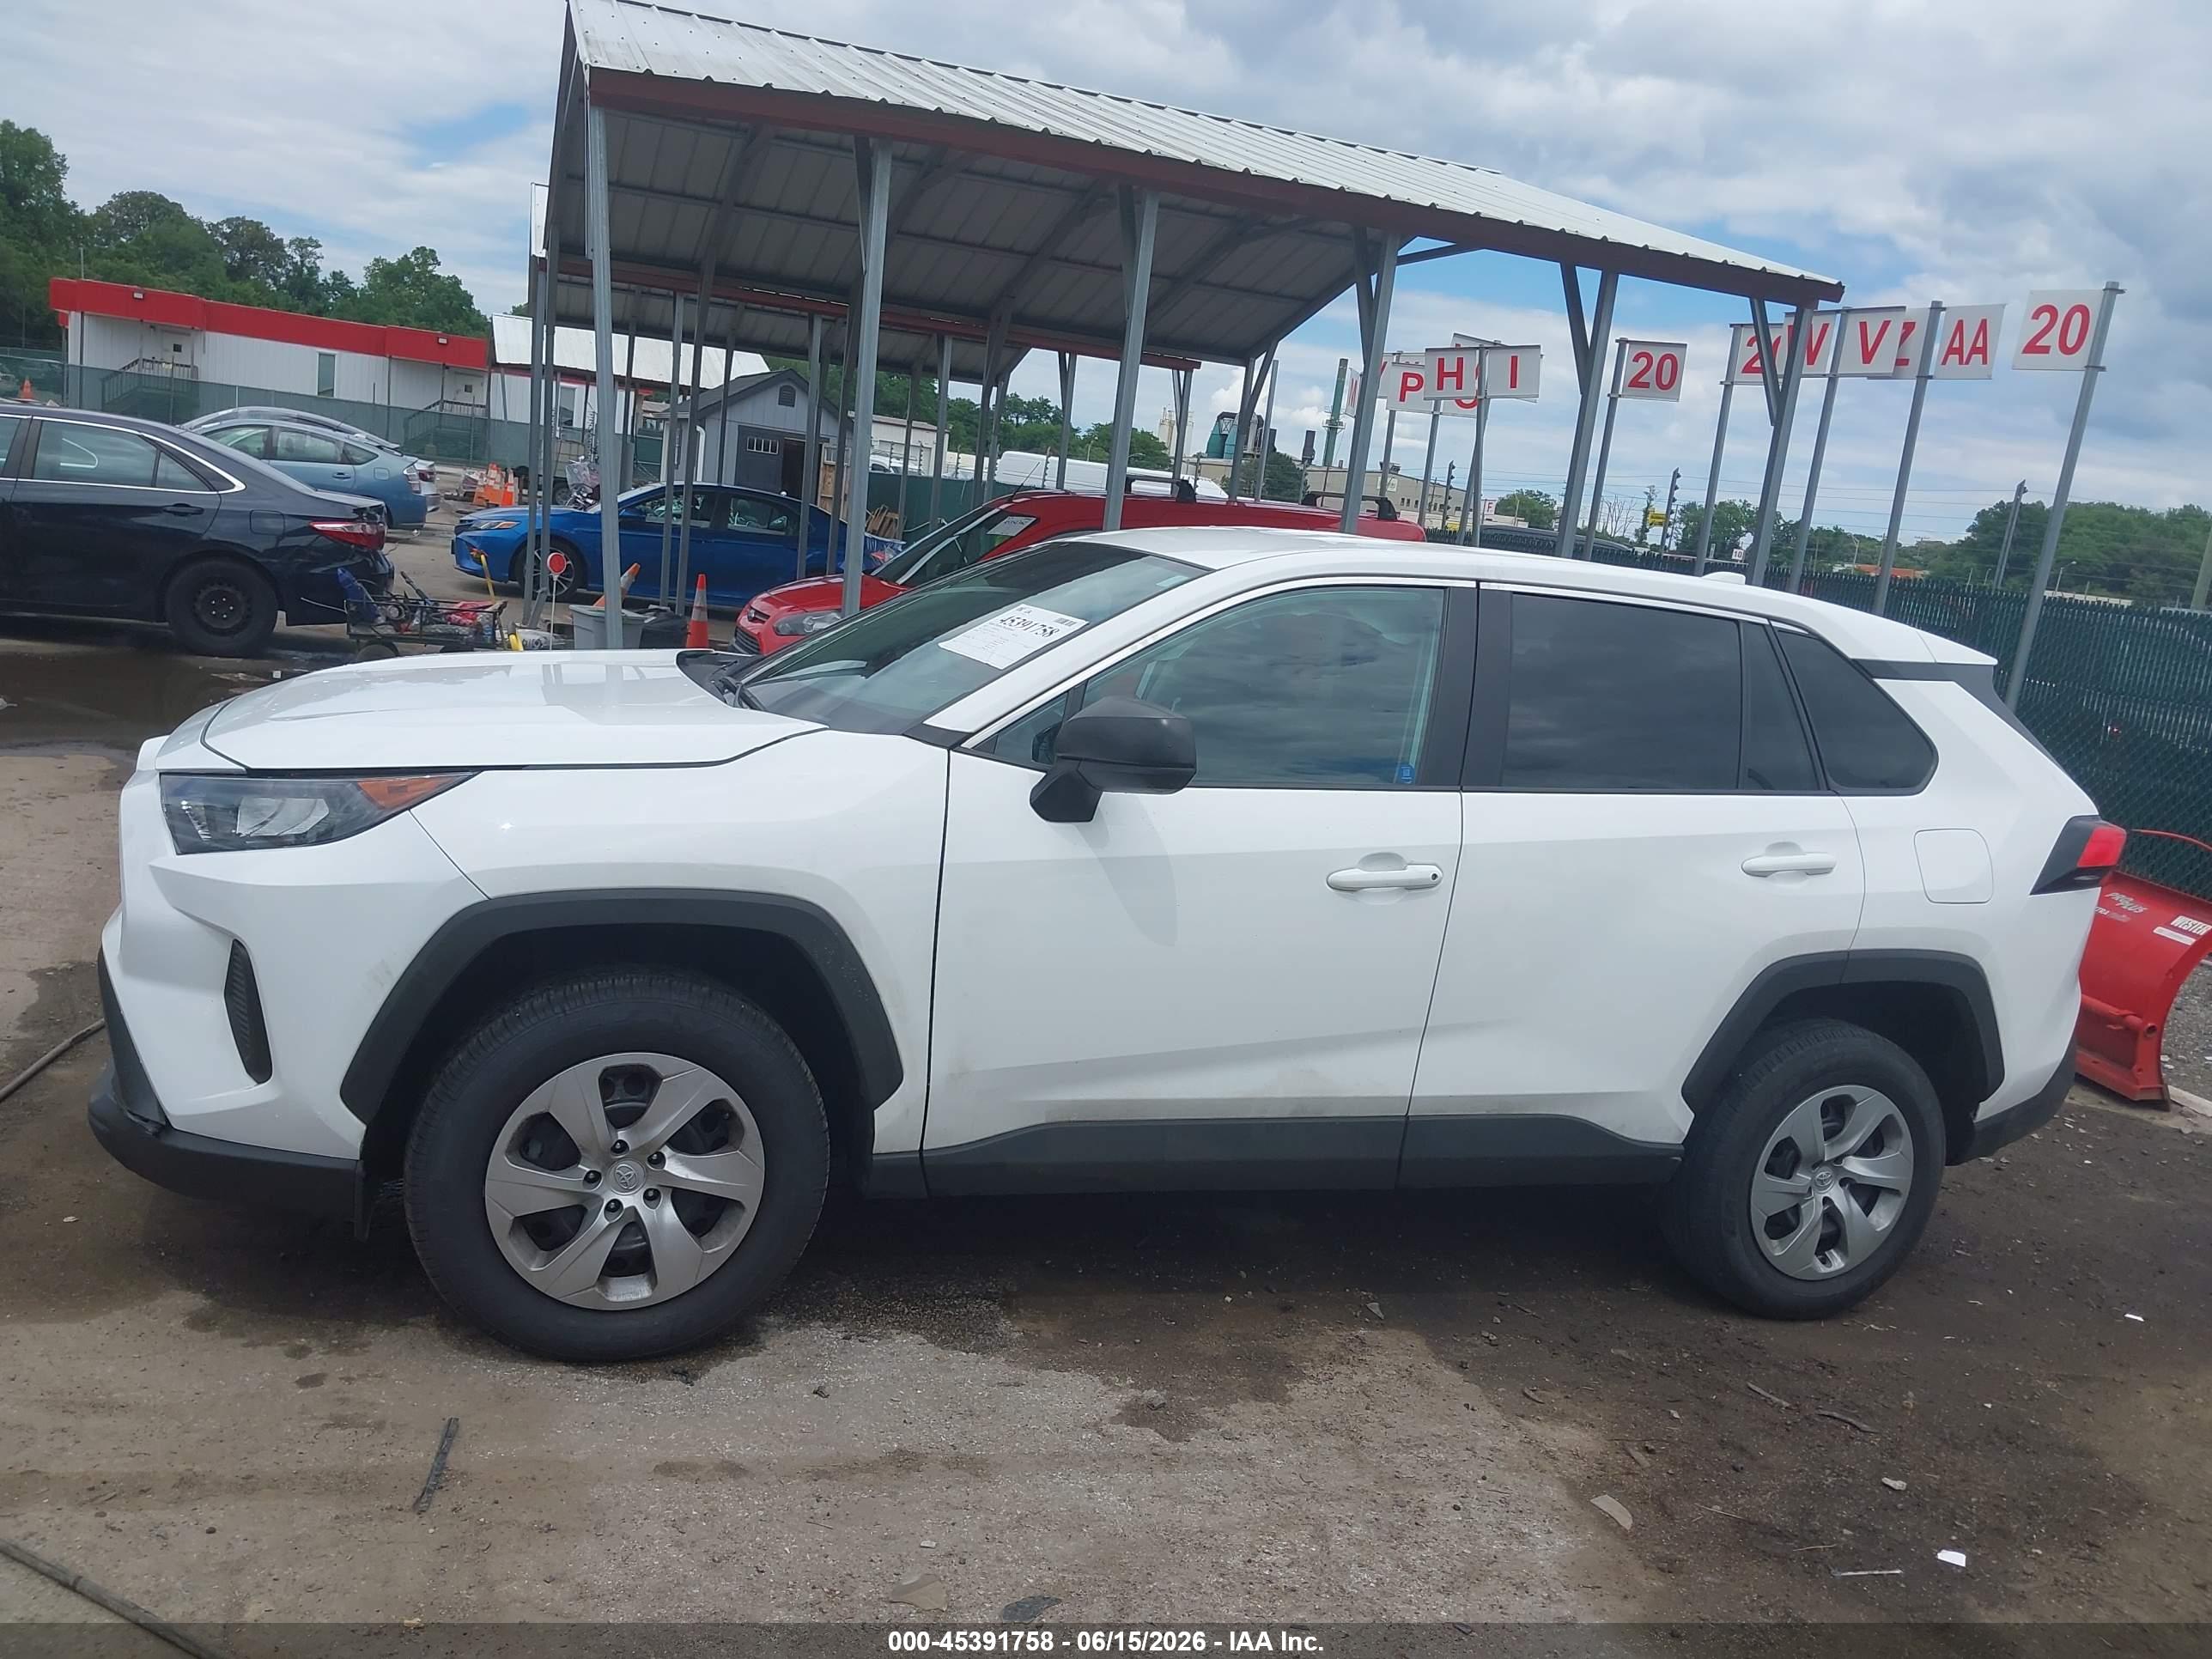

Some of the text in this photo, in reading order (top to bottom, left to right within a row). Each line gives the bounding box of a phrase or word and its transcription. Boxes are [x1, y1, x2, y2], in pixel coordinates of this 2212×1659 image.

[1787, 322, 1830, 366] W
[1858, 319, 1892, 364] V
[1941, 318, 1988, 365] AA
[2021, 303, 2091, 356] 20
[1399, 372, 1424, 403] P
[1437, 356, 1464, 391] H
[1510, 355, 1518, 389] I
[1627, 351, 1678, 391] 20
[1487, 501, 1494, 513] F
[999, 616, 1060, 638] 45391758
